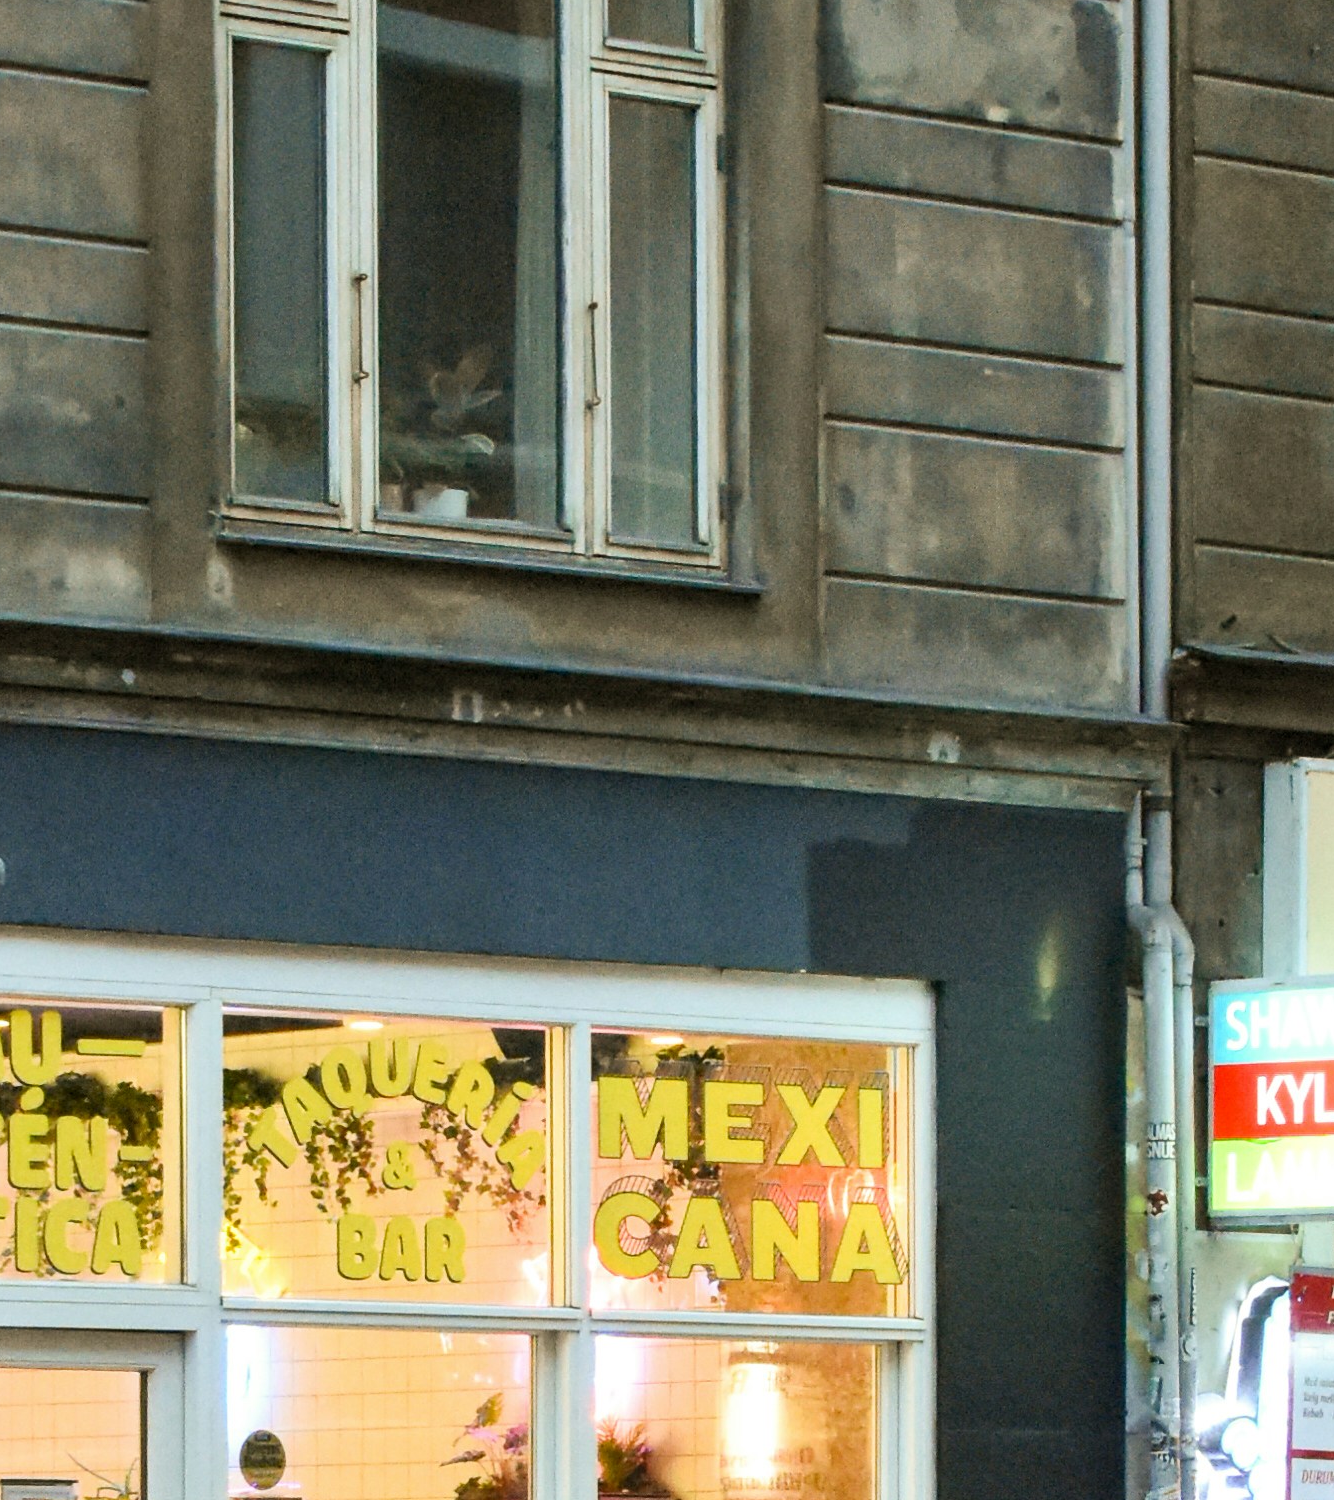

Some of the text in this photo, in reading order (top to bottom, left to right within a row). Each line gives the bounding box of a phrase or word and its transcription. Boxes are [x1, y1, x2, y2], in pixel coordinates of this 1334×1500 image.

[596, 1062, 889, 1169] MEXI
[381, 1139, 417, 1190] &
[336, 1213, 466, 1283] BAR
[593, 1182, 909, 1285] CANA
